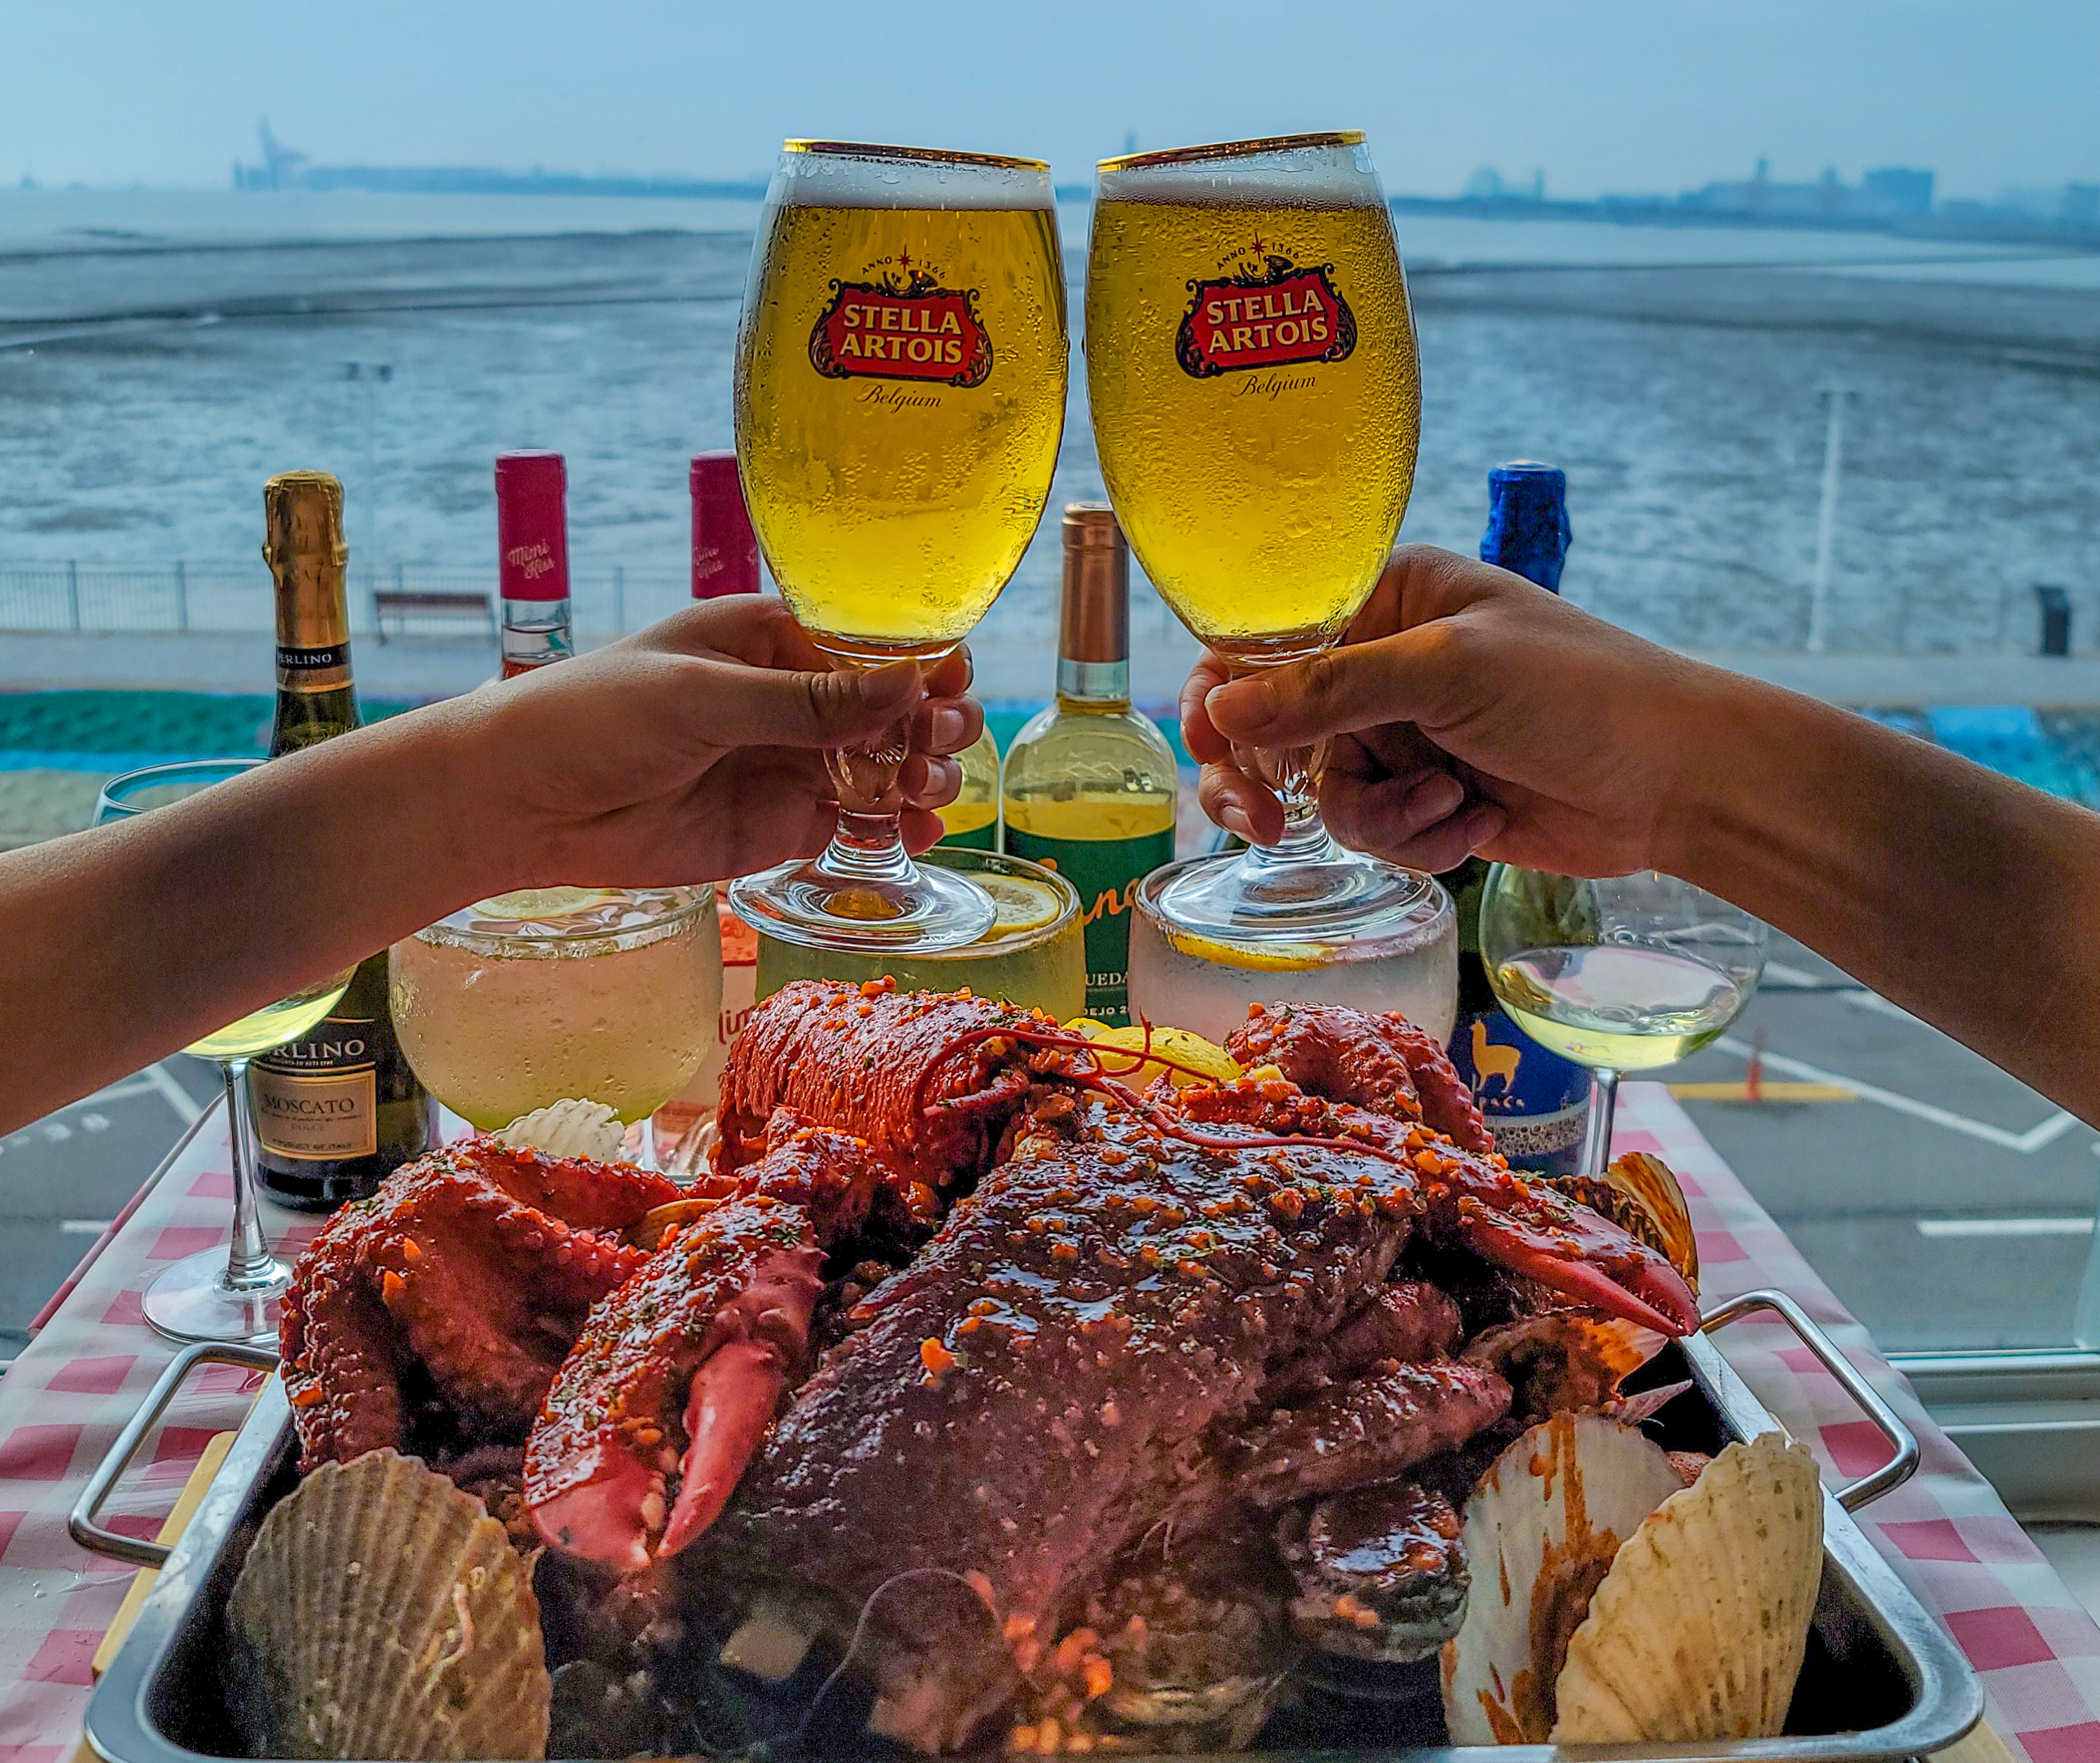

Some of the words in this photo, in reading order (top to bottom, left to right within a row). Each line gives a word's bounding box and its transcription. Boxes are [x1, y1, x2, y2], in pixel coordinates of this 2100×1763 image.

[861, 255, 893, 275] ANNO
[919, 259, 946, 279] 1366
[1216, 246, 1246, 270] ANNO
[1272, 242, 1299, 259] 1366
[844, 304, 962, 335] STELLA
[1207, 289, 1324, 325] STELLA
[1208, 317, 1329, 353] ARTOIS
[839, 333, 962, 364] ARTOIS
[854, 385, 943, 414] Belgium
[1230, 373, 1317, 401] Belgium
[524, 559, 555, 580] Kiss
[280, 653, 332, 665] ERLINO
[1085, 971, 1128, 986] UEDA
[1084, 1006, 1115, 1016] DEJO
[272, 1039, 365, 1058] RLINO
[265, 1095, 354, 1115] MOSCATO
